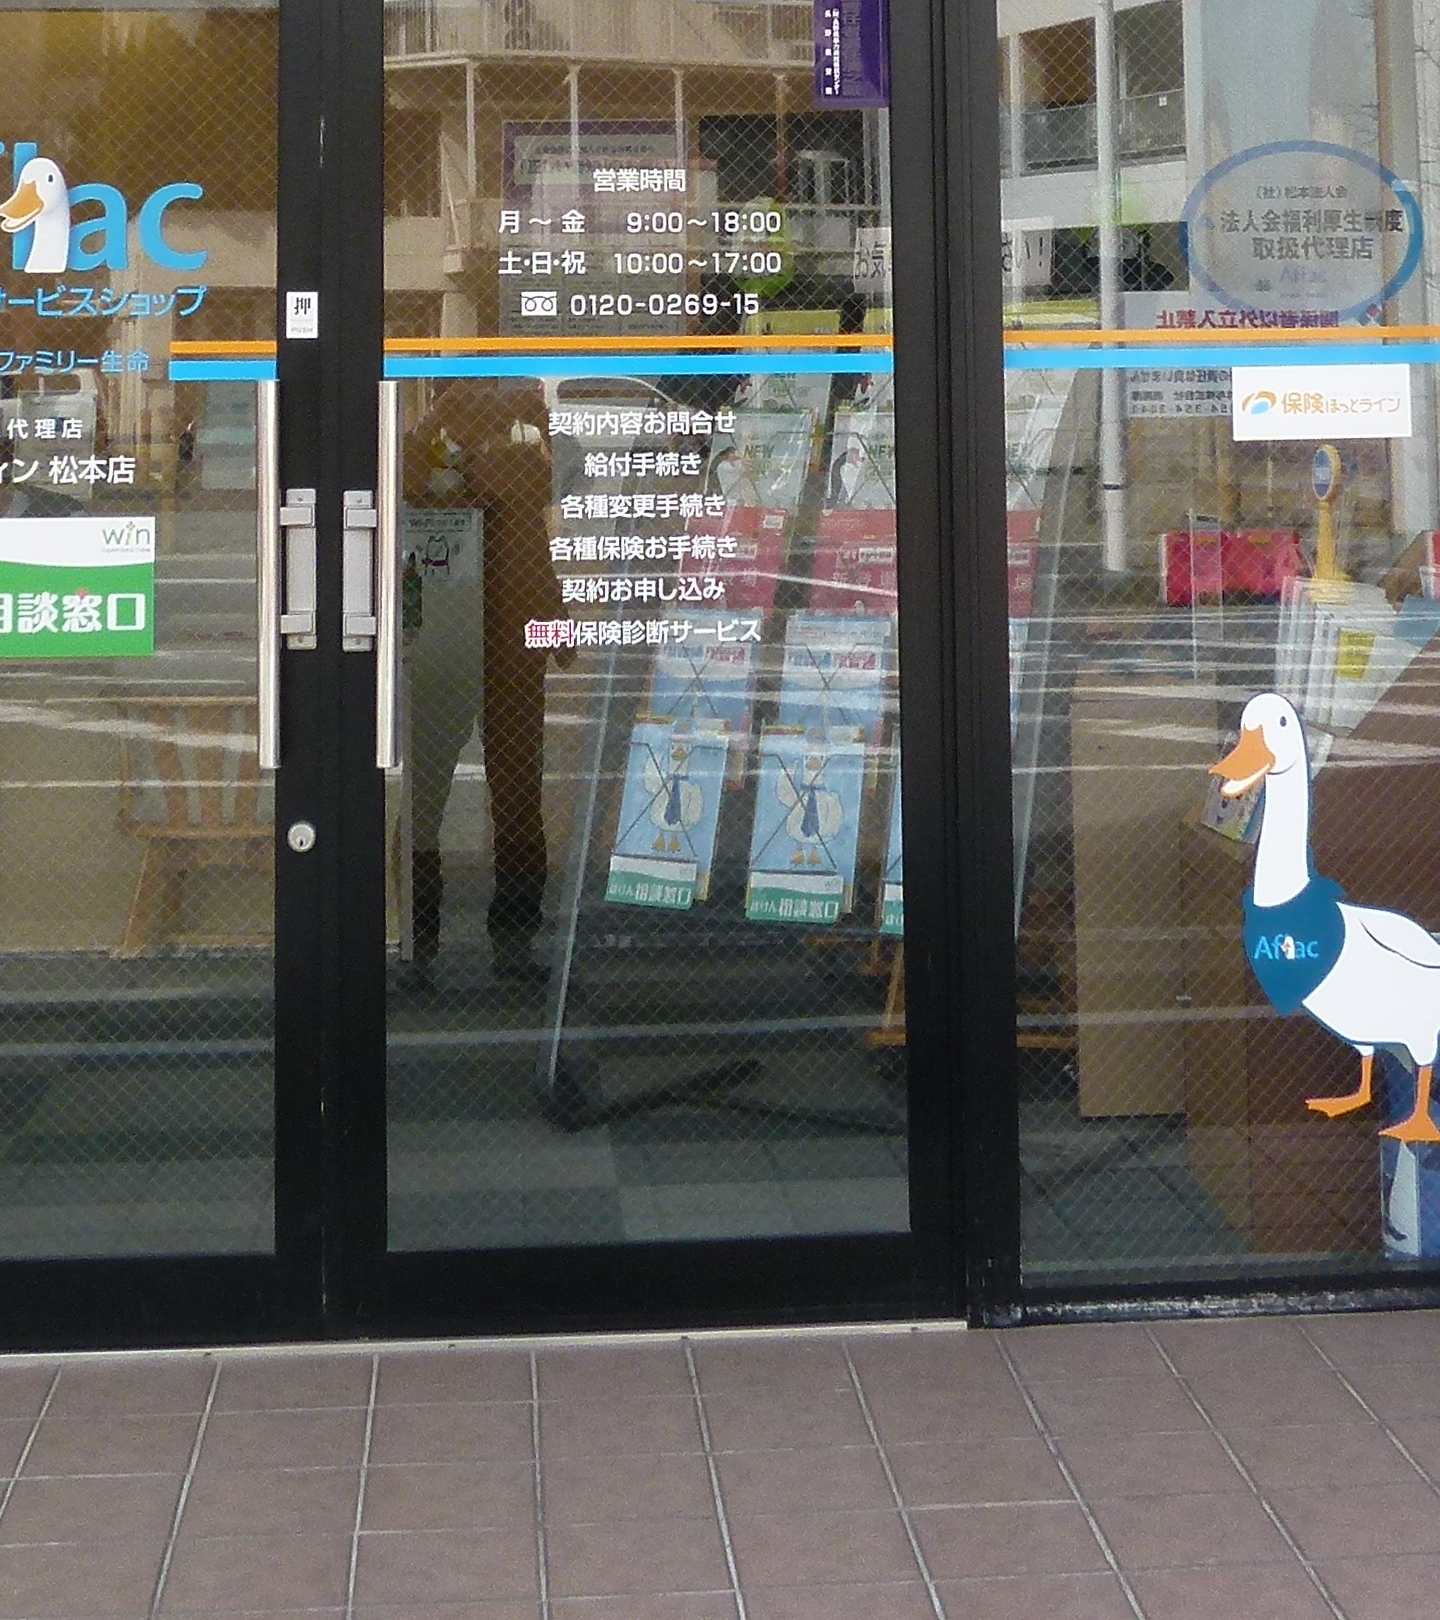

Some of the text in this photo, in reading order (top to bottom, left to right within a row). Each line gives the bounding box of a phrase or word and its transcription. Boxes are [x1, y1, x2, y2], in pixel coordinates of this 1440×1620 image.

[593, 169, 687, 193] 営業時間
[1252, 236, 1375, 260] 取扱代理店
[614, 252, 782, 275] 10:00～17:00
[570, 294, 759, 317] 0120-0269-15
[1282, 392, 1402, 415] 保険ほっとライン
[549, 410, 737, 437] 契約内容お問合せ
[48, 455, 136, 484] 松本店
[584, 453, 702, 477] 給付手続き
[560, 494, 727, 520] 各種変更手続き
[102, 521, 151, 545] win
[549, 536, 738, 562] 各種保険お手続き
[562, 578, 726, 603] 契約お申し込み
[524, 619, 762, 648] 無料保険診断サービス
[1254, 934, 1319, 960] Aflac
